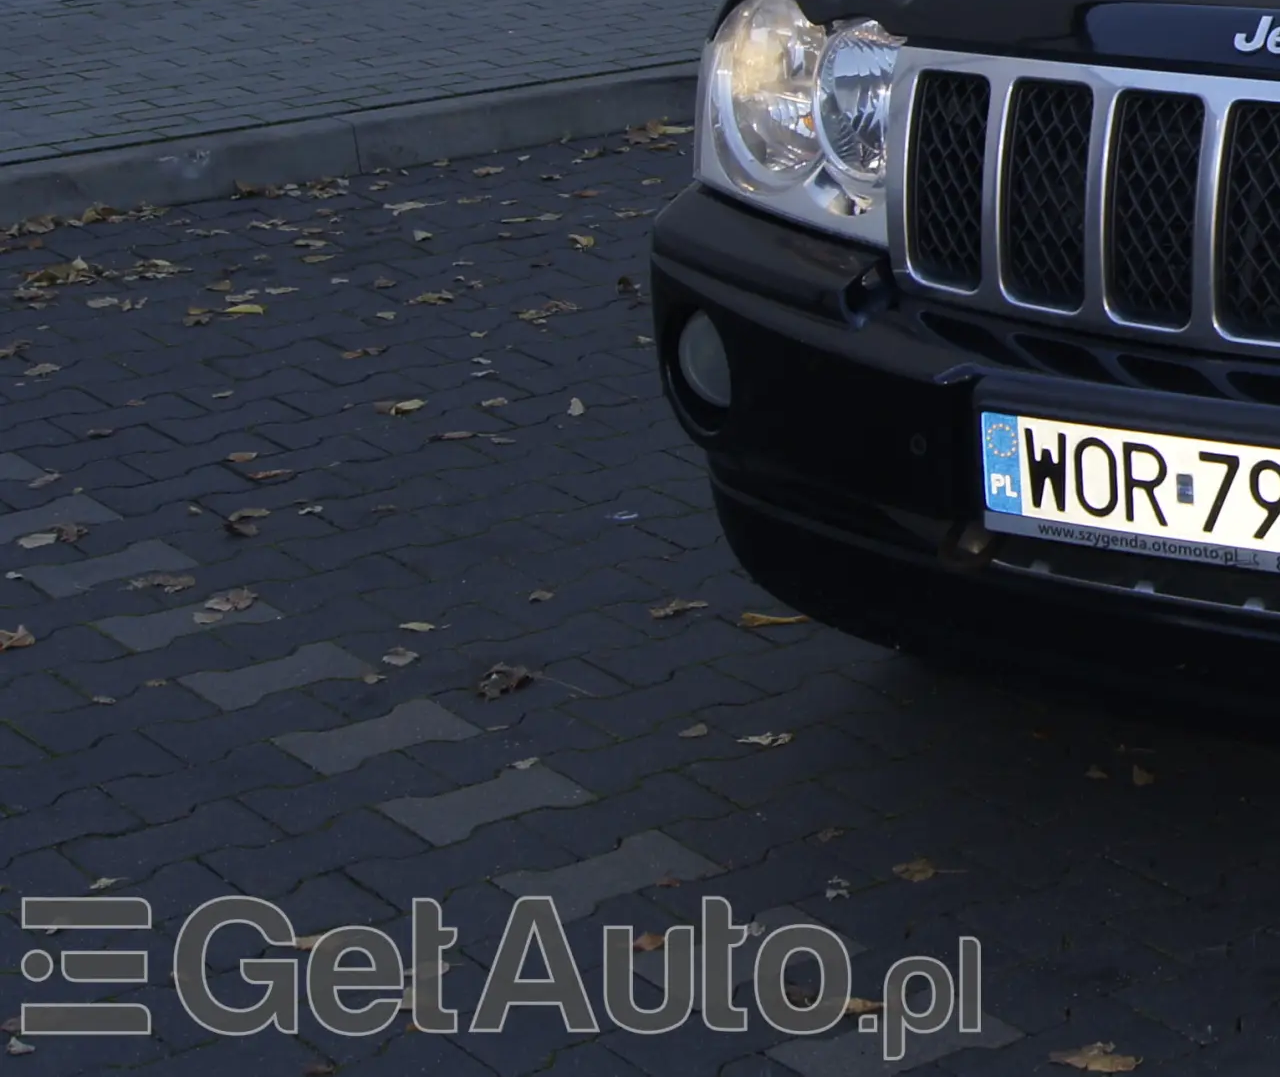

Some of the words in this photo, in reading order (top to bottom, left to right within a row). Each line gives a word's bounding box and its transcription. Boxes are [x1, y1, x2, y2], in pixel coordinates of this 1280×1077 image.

[990, 473, 1018, 498] PL
[1024, 427, 1168, 527] WOR
[1038, 523, 1239, 565] www.szygenda.otomoto.pl
